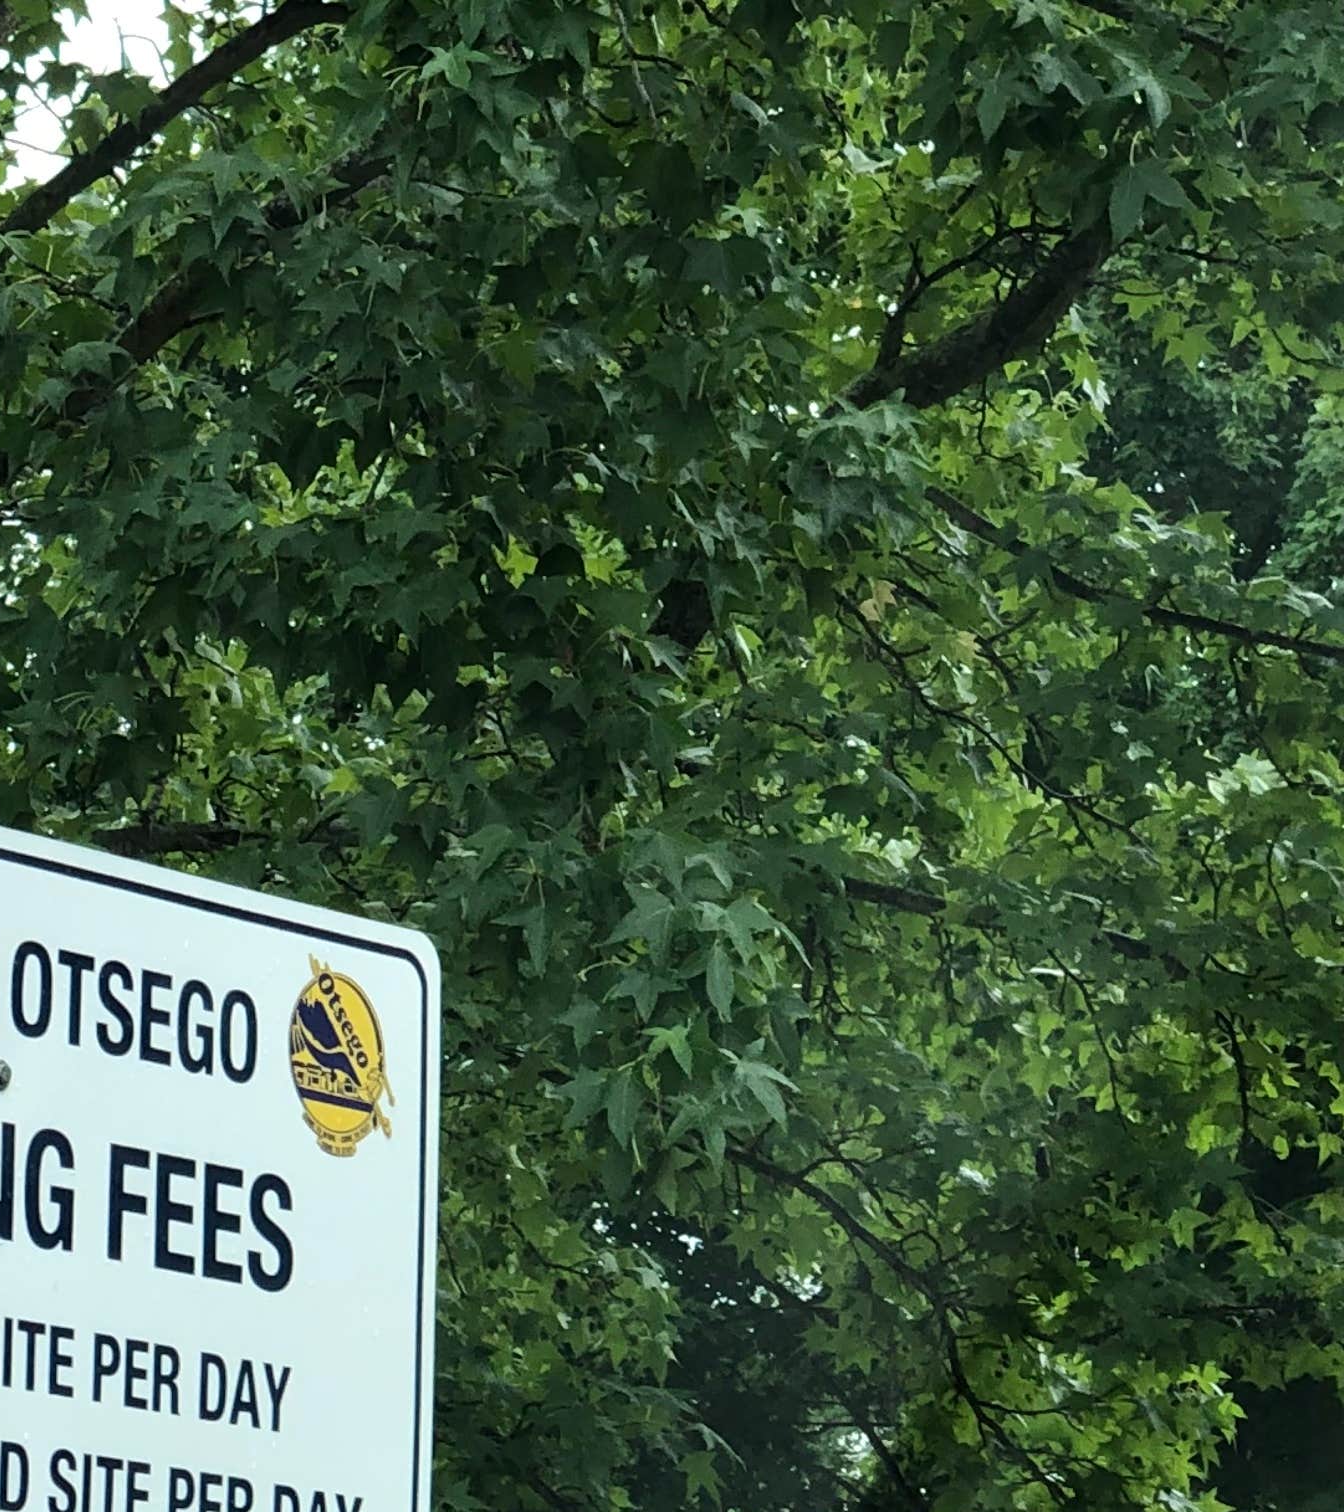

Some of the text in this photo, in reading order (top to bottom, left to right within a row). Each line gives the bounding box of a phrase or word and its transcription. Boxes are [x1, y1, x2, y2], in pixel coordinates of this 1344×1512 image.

[11, 940, 258, 1084] OTSEGO
[317, 972, 369, 1069] Otsego
[107, 1143, 294, 1293] FEES
[92, 1333, 180, 1416] PER
[199, 1352, 291, 1432] DAY
